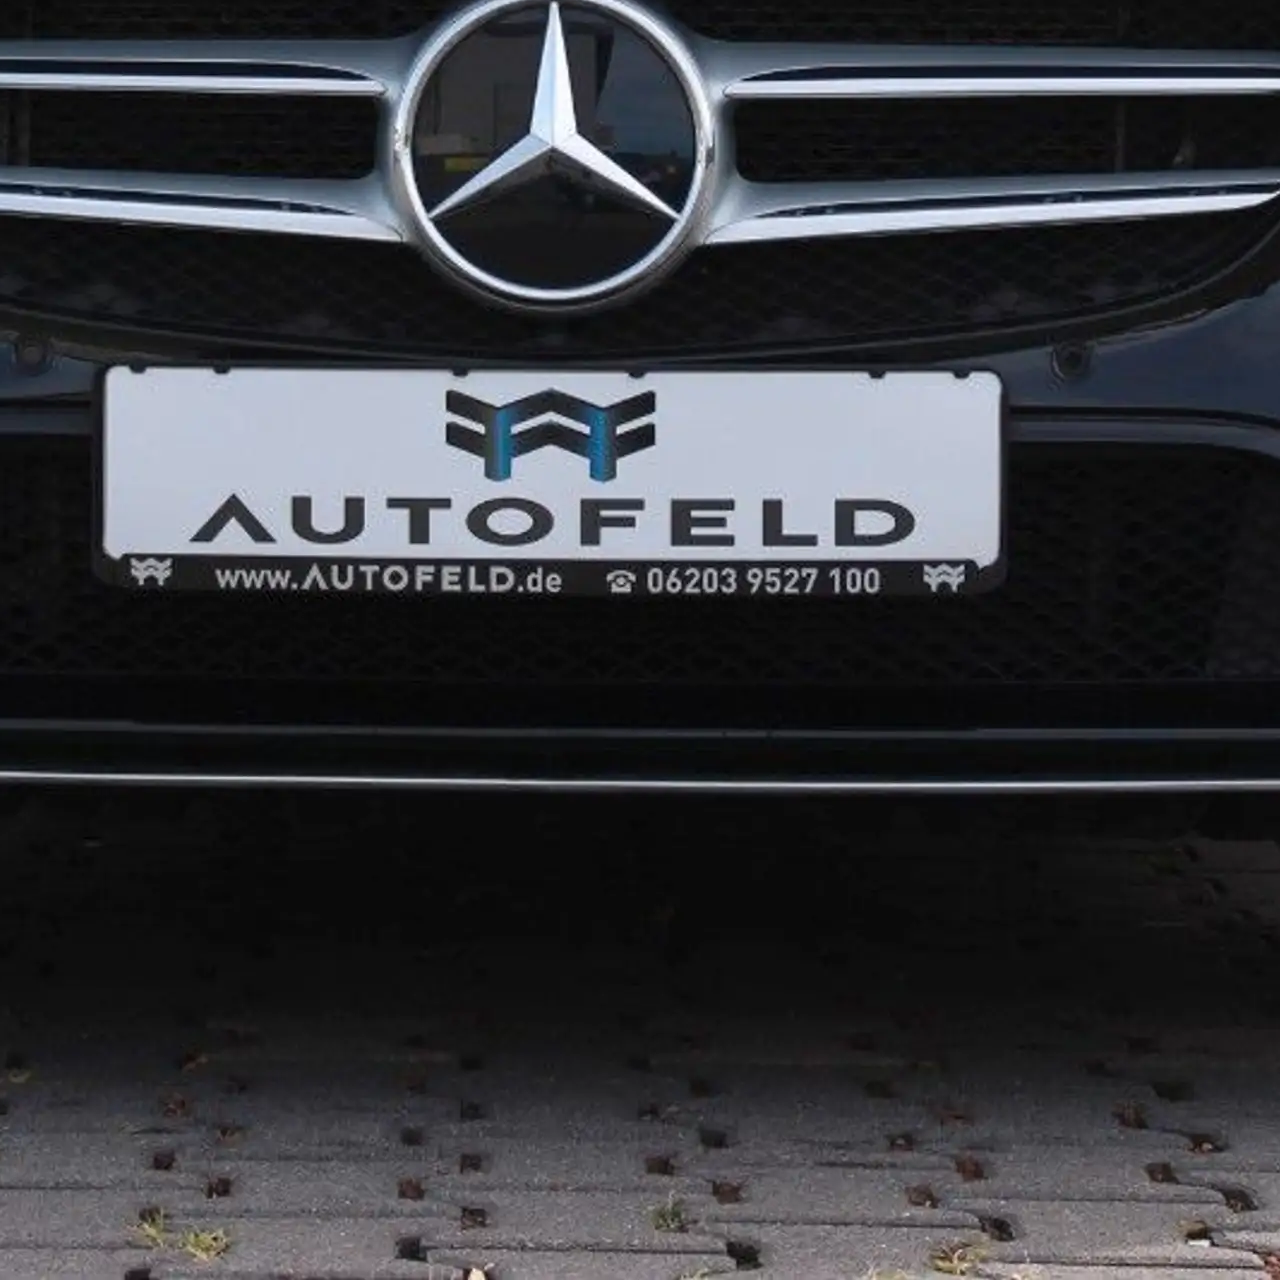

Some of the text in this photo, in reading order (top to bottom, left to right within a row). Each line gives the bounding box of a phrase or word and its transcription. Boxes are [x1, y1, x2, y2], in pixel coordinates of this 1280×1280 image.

[187, 492, 917, 548] AUTOFELD
[214, 562, 563, 593] www.AUTOFELD.de
[646, 567, 881, 594] 06203 9527 100
